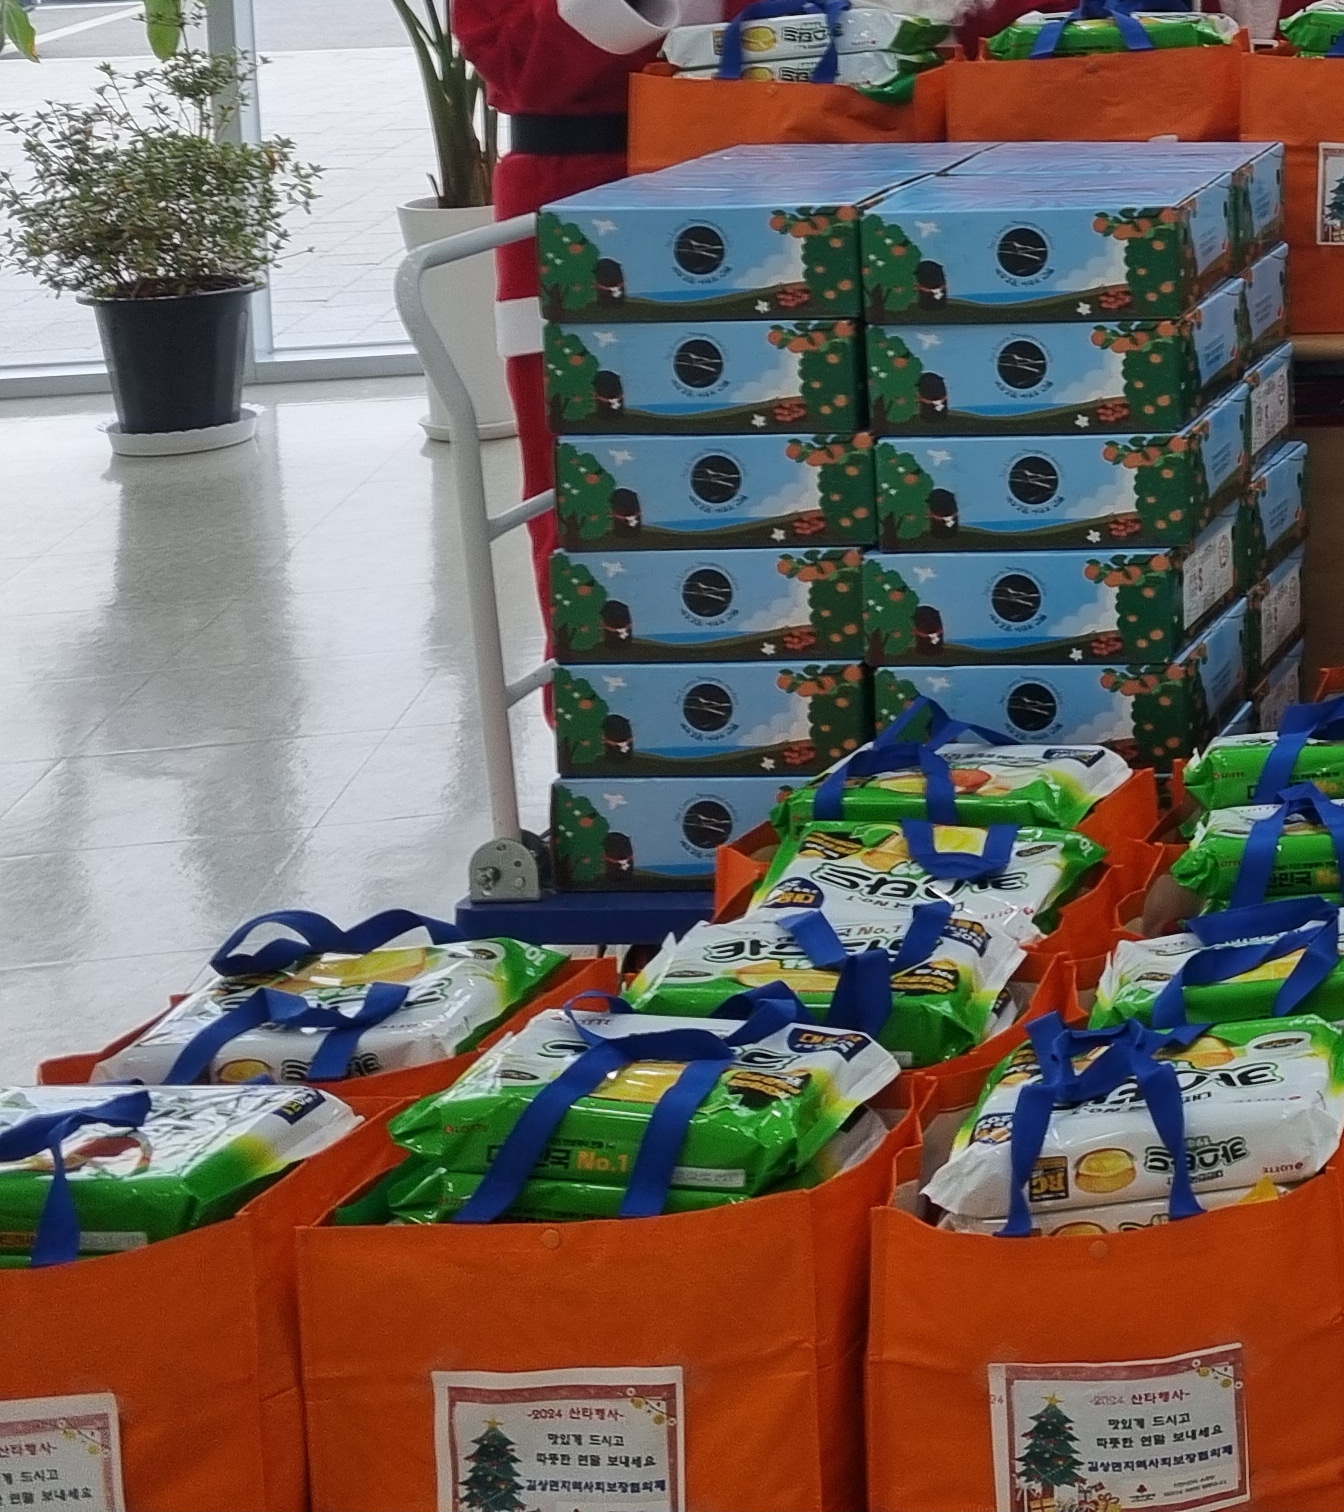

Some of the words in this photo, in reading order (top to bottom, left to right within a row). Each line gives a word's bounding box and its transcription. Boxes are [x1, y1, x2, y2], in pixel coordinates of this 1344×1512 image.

[577, 1149, 630, 1173] No.1
[1151, 1412, 1191, 1427] 드시고
[589, 1433, 625, 1446] 드시고
[20, 1468, 59, 1483] 드시고
